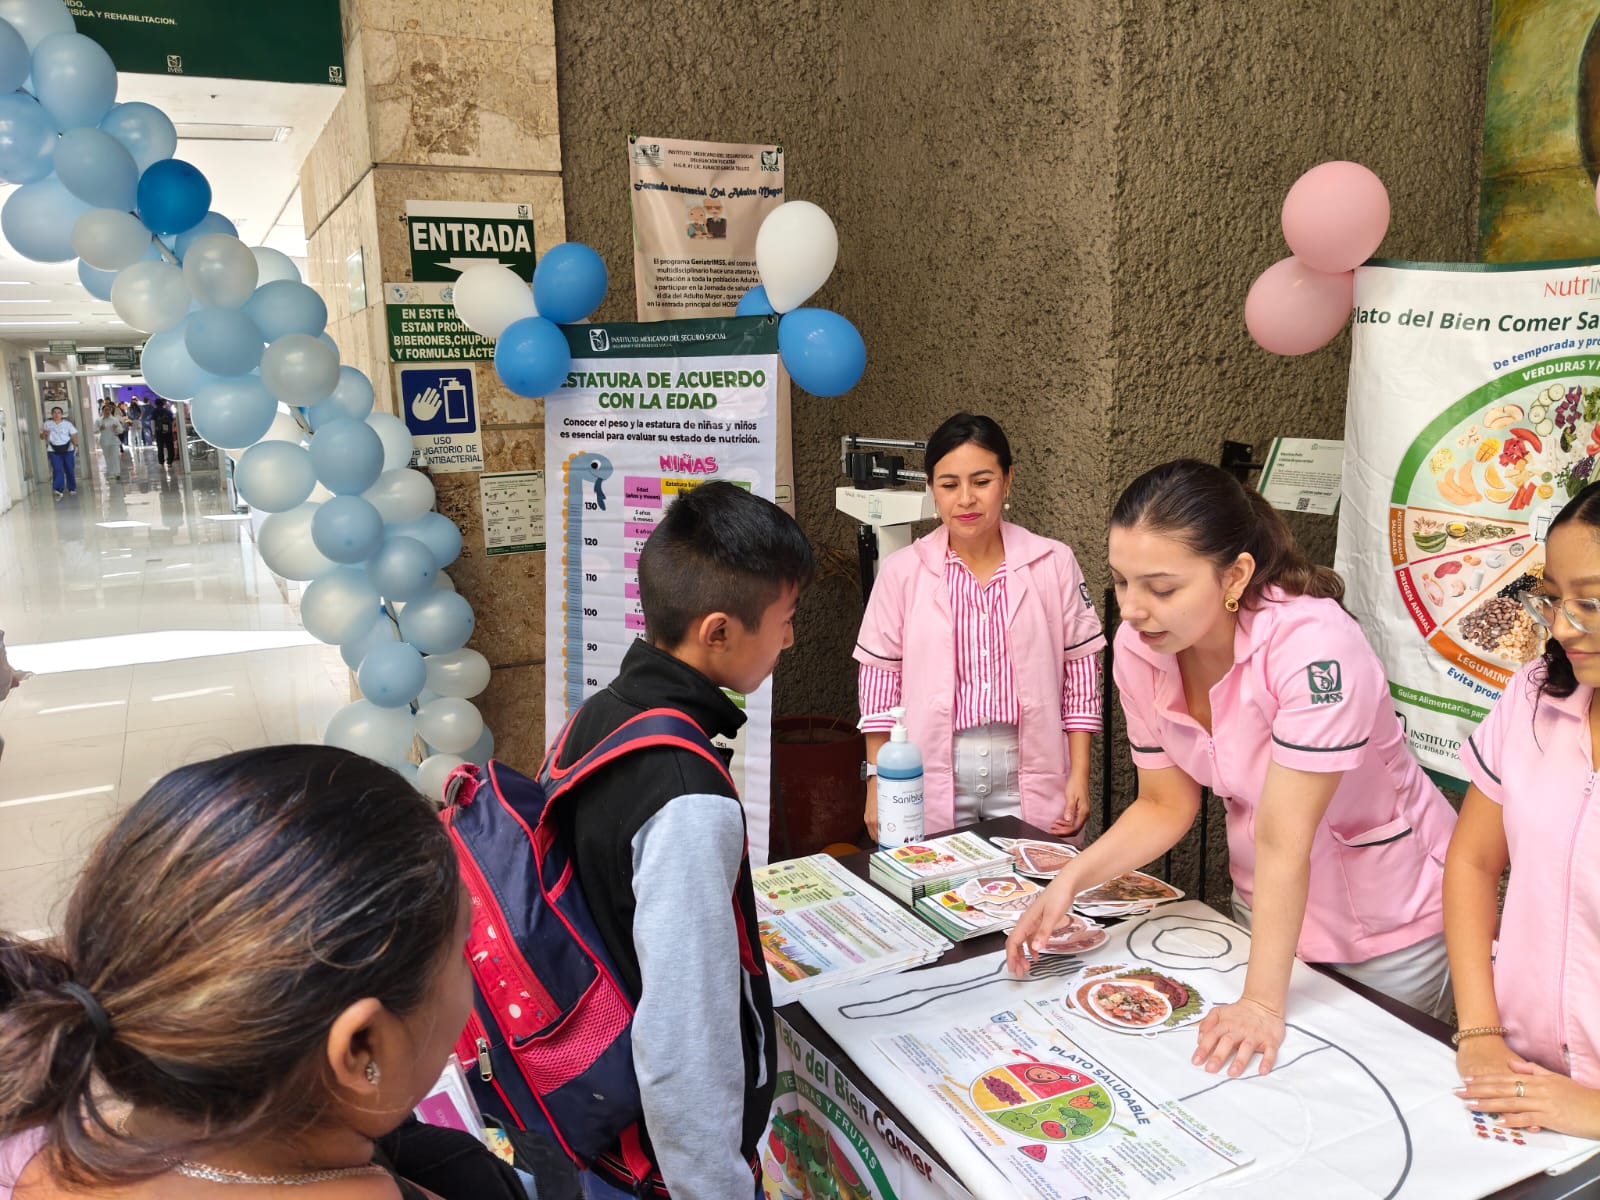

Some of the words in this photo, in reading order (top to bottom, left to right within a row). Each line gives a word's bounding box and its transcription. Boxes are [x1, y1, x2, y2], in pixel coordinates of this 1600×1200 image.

[71, 9, 95, 17] ISICA
[412, 222, 531, 252] ENTRADA
[402, 309, 416, 319] EN
[419, 309, 444, 319] ESTE
[1398, 308, 1434, 328] del
[1440, 312, 1491, 331] Bien
[1498, 314, 1572, 332] Comer
[402, 322, 434, 332] ESTAN
[396, 349, 403, 358] Y
[406, 348, 460, 358] FORMULAS
[1493, 358, 1509, 371] De
[1512, 339, 1575, 364] temporada
[1578, 338, 1585, 349] y
[1522, 361, 1586, 381] VERDURAS
[1588, 361, 1595, 370] Y
[647, 372, 671, 389] DE
[675, 370, 766, 389] ACUERDO
[599, 392, 635, 409] CON
[639, 392, 662, 410] LA
[666, 392, 718, 410] EDAD
[564, 418, 597, 428] Conocer
[600, 418, 607, 427] el
[608, 421, 628, 430] peso
[630, 421, 635, 430] y
[637, 419, 644, 429] la
[645, 420, 680, 430] estatura
[683, 420, 696, 430] de
[698, 419, 723, 430] niñas
[725, 422, 731, 431] y
[734, 419, 757, 430] niños
[572, 431, 604, 440] esencial
[606, 432, 624, 441] para
[627, 432, 656, 442] evaluar
[658, 434, 668, 442] su
[670, 433, 701, 443] estado
[704, 434, 716, 443] de
[719, 433, 760, 444] nutrición.
[466, 445, 477, 453] DE
[427, 454, 482, 465] NTIBACTERIAL
[659, 453, 718, 474] NIÑAS
[585, 502, 597, 510] 130
[584, 538, 598, 546] 120
[586, 574, 597, 582] 110
[1399, 570, 1413, 601] ORIGEN
[1411, 602, 1430, 633] ANIMAL
[584, 608, 597, 616] 100
[587, 643, 597, 651] 90
[1447, 667, 1473, 688] Evita
[1310, 692, 1343, 704] IMSS
[1419, 695, 1470, 714] Alimentarias
[1411, 729, 1461, 750] INSTITUTO
[1049, 1045, 1094, 1071] PLATO
[1092, 1069, 1150, 1125] SALUDABLE
[806, 1047, 829, 1089] del
[835, 1068, 869, 1128] Bien
[873, 1110, 933, 1183] Comer
[825, 1101, 832, 1111] Y
[835, 1111, 877, 1170] FRUTAS
